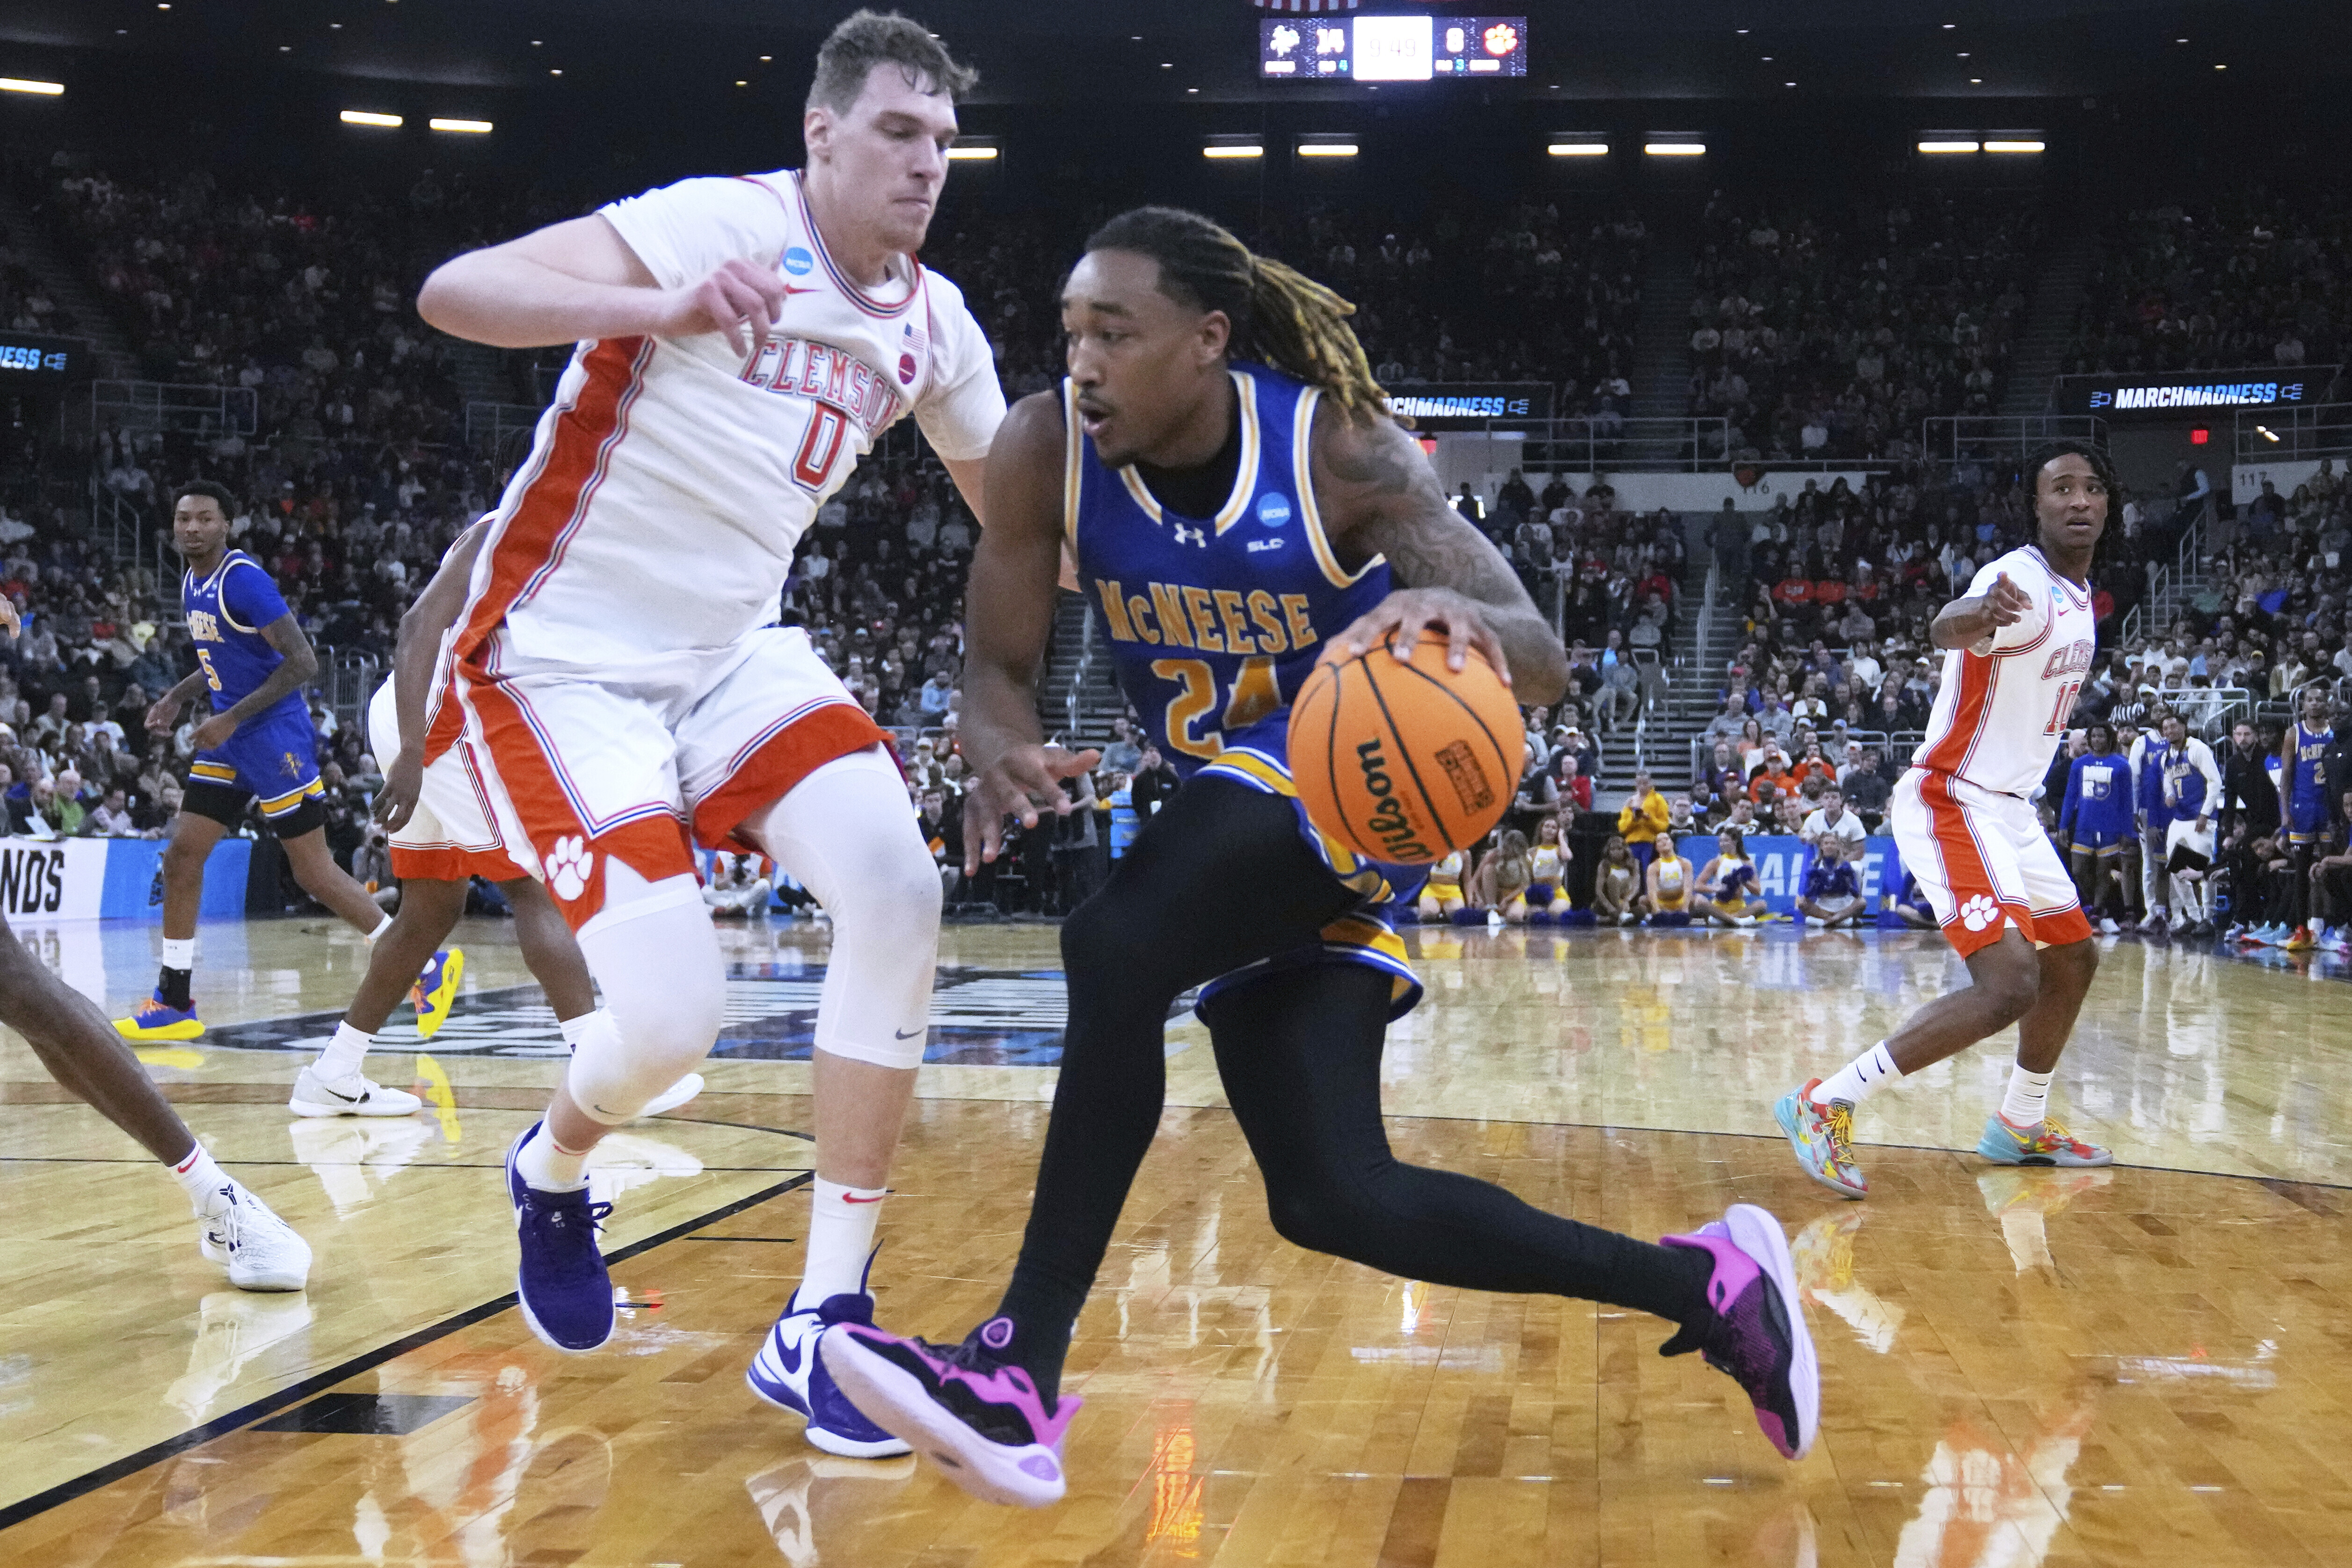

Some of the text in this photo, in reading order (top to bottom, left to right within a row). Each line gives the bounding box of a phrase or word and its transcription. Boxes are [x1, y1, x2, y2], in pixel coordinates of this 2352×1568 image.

[1316, 29, 1345, 54] 14
[1446, 27, 1464, 52] 8
[1455, 58, 1465, 71] 3
[2115, 382, 2278, 409] MARCHMADNESS
[791, 398, 851, 494] 0
[1095, 578, 1318, 654] McNEESE
[197, 649, 222, 691] 5
[1151, 656, 1283, 760] 24
[0, 848, 65, 914] NDS
